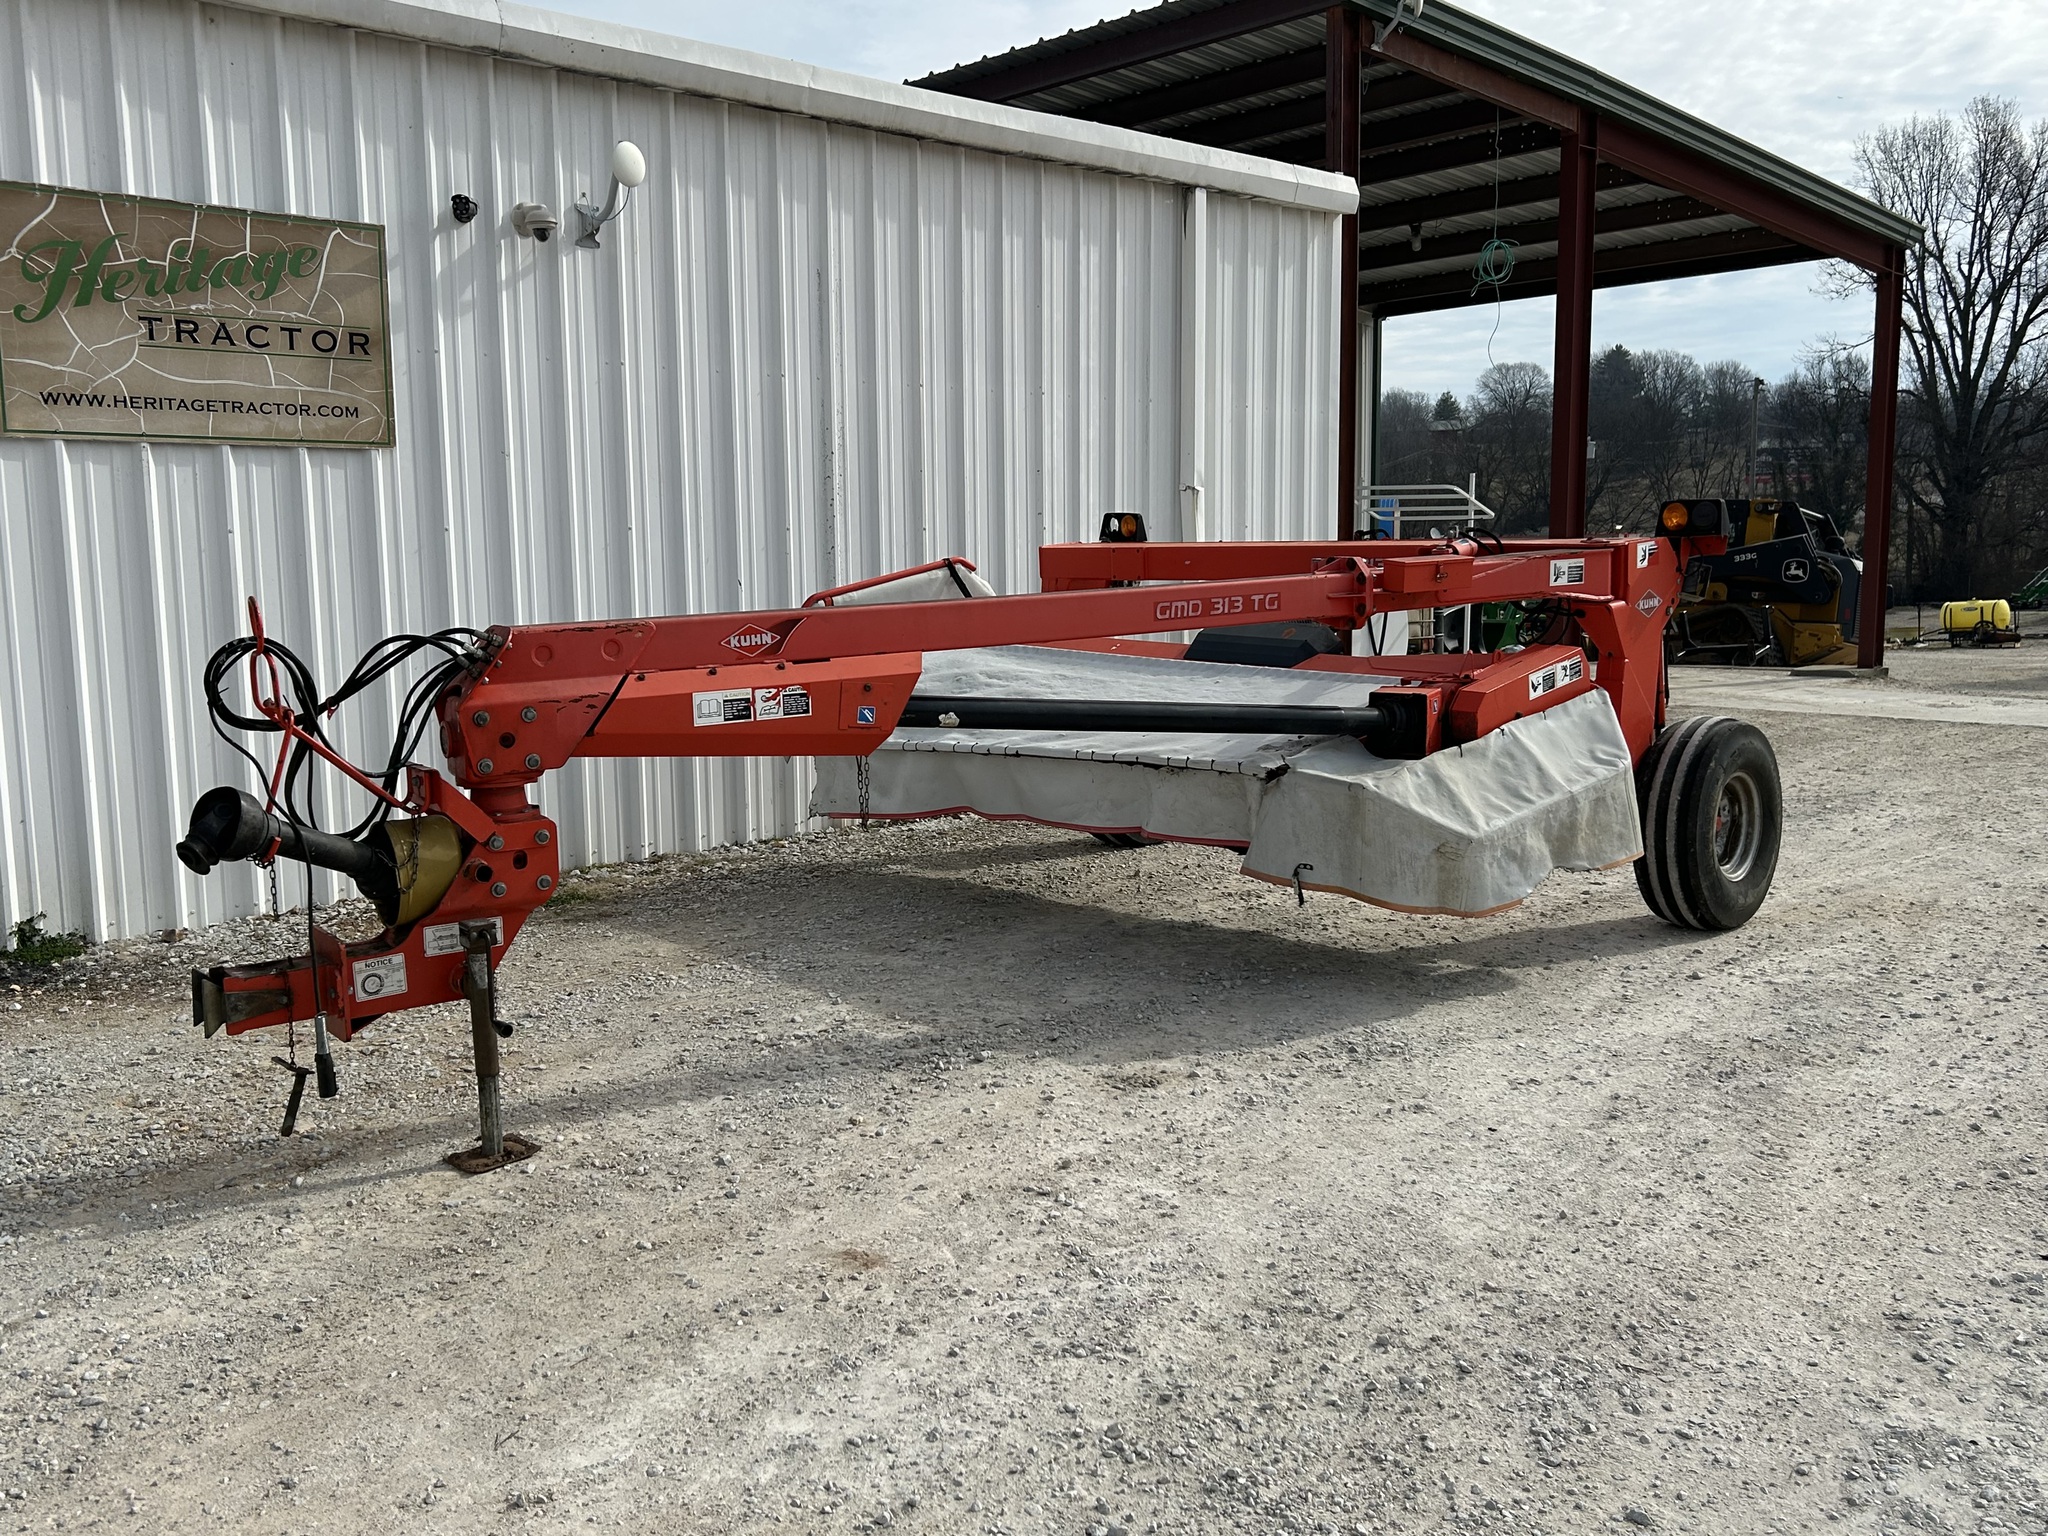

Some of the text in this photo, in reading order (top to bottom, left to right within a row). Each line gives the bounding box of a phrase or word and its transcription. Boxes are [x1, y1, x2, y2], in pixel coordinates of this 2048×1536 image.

[13, 232, 323, 324] Heritage
[137, 315, 371, 356] TRACTOR
[39, 391, 360, 419] WWW.HERITAGETRACTOR.COM
[1733, 553, 1757, 562] 333G
[1156, 593, 1279, 620] GMD 313 TG
[1639, 597, 1659, 610] KUHN
[729, 632, 772, 648] KUHN
[364, 957, 393, 969] NOTICE
